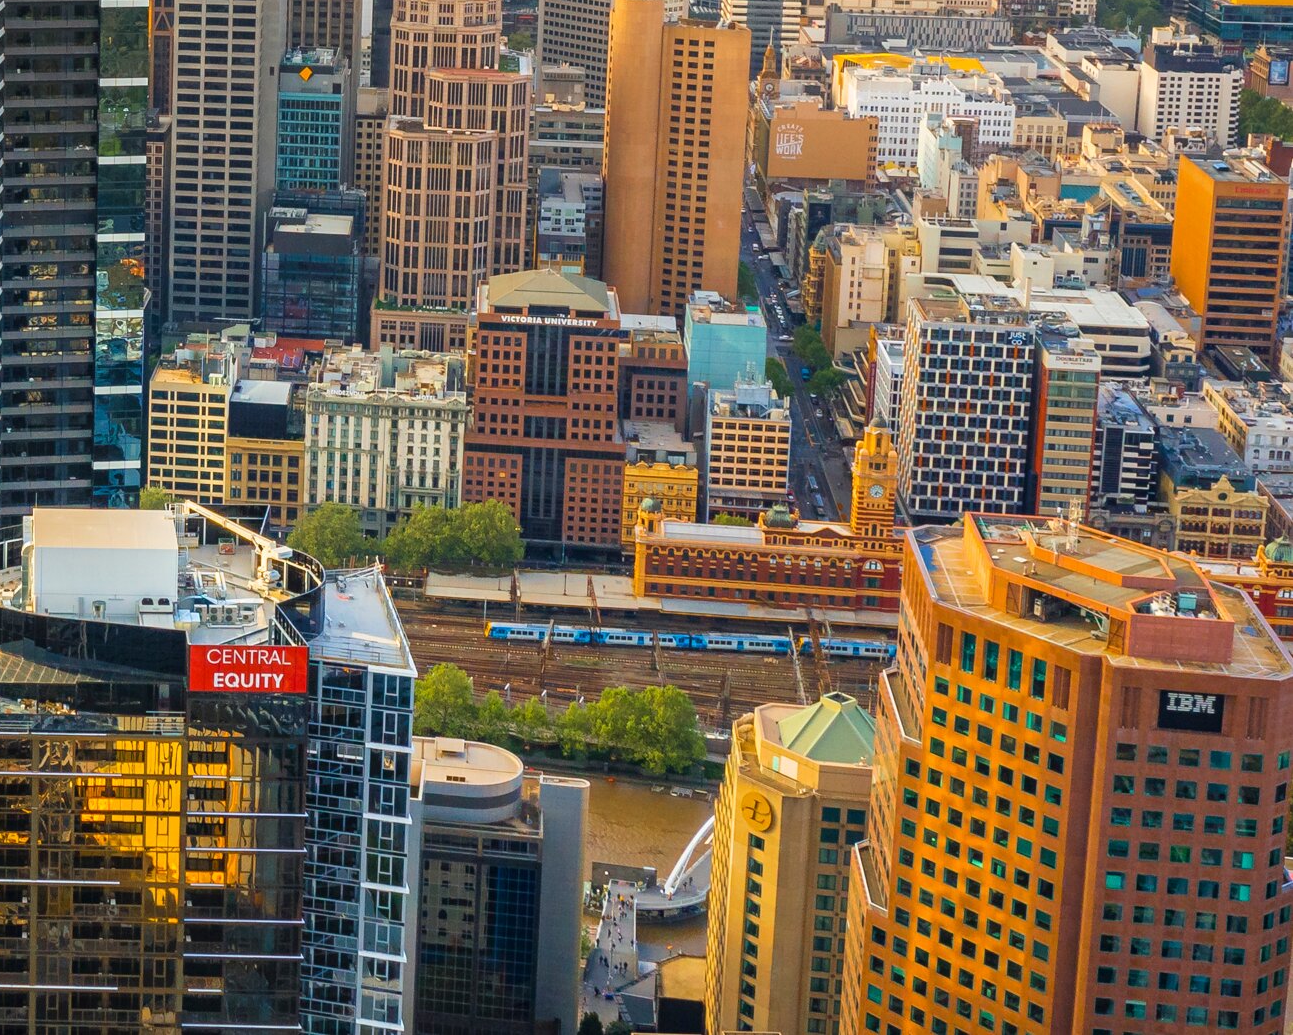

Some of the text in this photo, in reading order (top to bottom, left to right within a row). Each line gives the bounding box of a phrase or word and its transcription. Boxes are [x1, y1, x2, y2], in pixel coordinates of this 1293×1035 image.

[777, 123, 804, 133] CREATE
[776, 133, 804, 146] LIFE'S
[776, 143, 802, 155] WORK
[501, 315, 598, 327] VICTORIA UNIVERSITY
[206, 648, 292, 666] CENTRAL
[213, 672, 284, 689] EQUITY
[1166, 692, 1217, 714] IBM
